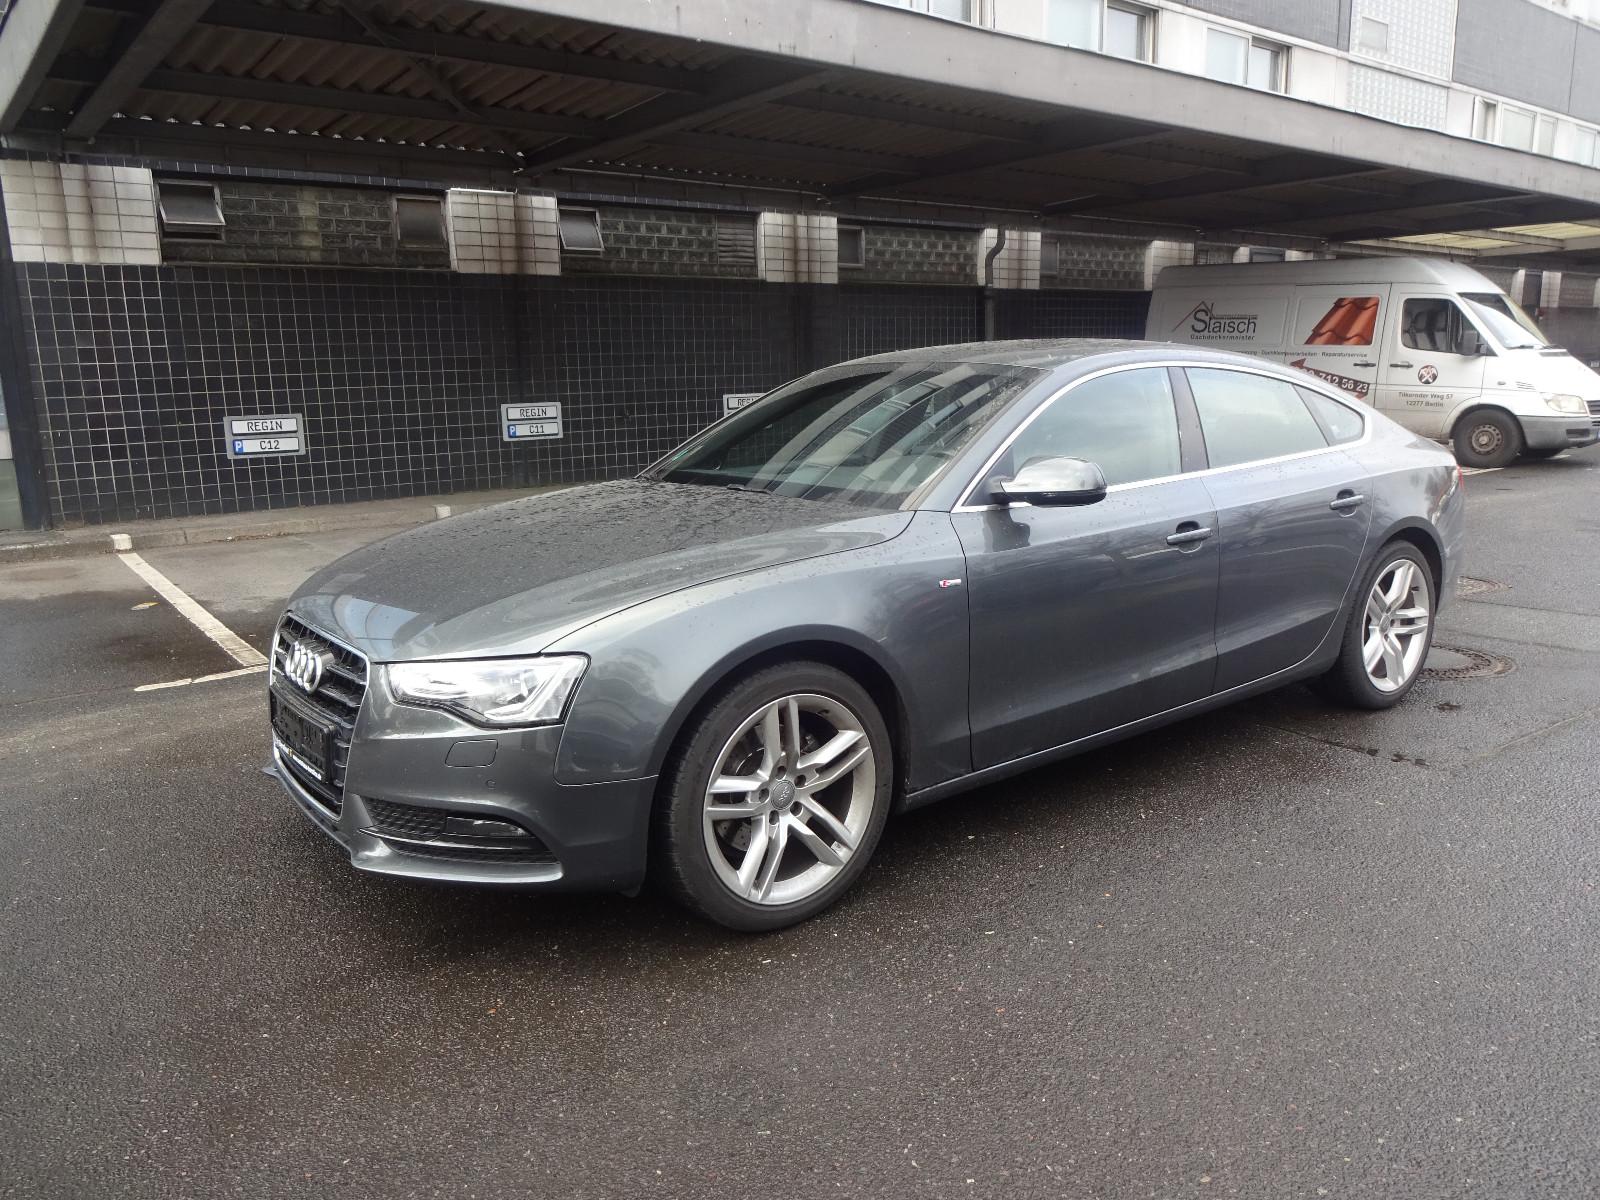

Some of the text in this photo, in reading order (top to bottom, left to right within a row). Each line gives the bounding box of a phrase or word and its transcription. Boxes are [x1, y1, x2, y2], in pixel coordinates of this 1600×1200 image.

[519, 407, 547, 418] REGIN
[247, 420, 283, 432] REGIN
[509, 425, 545, 436] P C11
[235, 440, 280, 453] P C12
